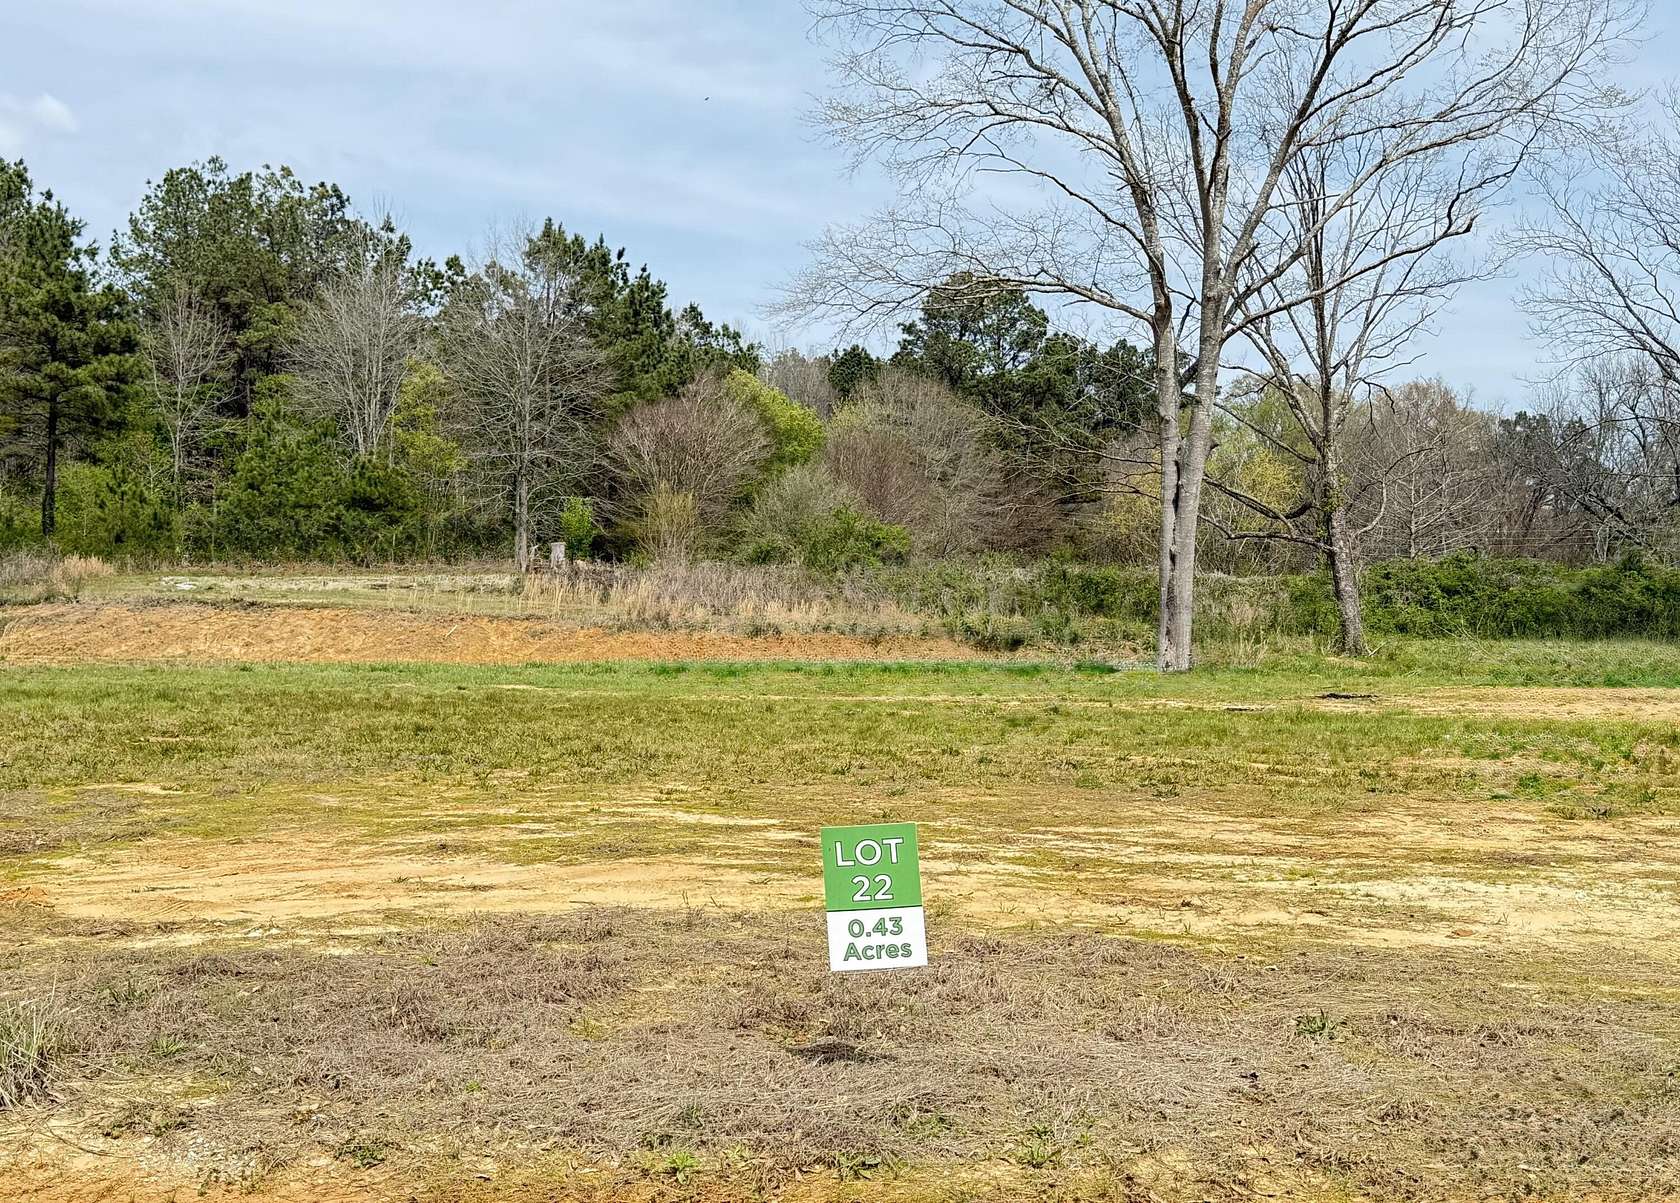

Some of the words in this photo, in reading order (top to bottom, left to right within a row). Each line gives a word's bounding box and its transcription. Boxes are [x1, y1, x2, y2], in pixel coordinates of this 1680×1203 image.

[834, 837, 904, 867] LOT
[851, 874, 894, 903] 22
[847, 917, 904, 938] 0.43
[843, 942, 913, 962] Acres
